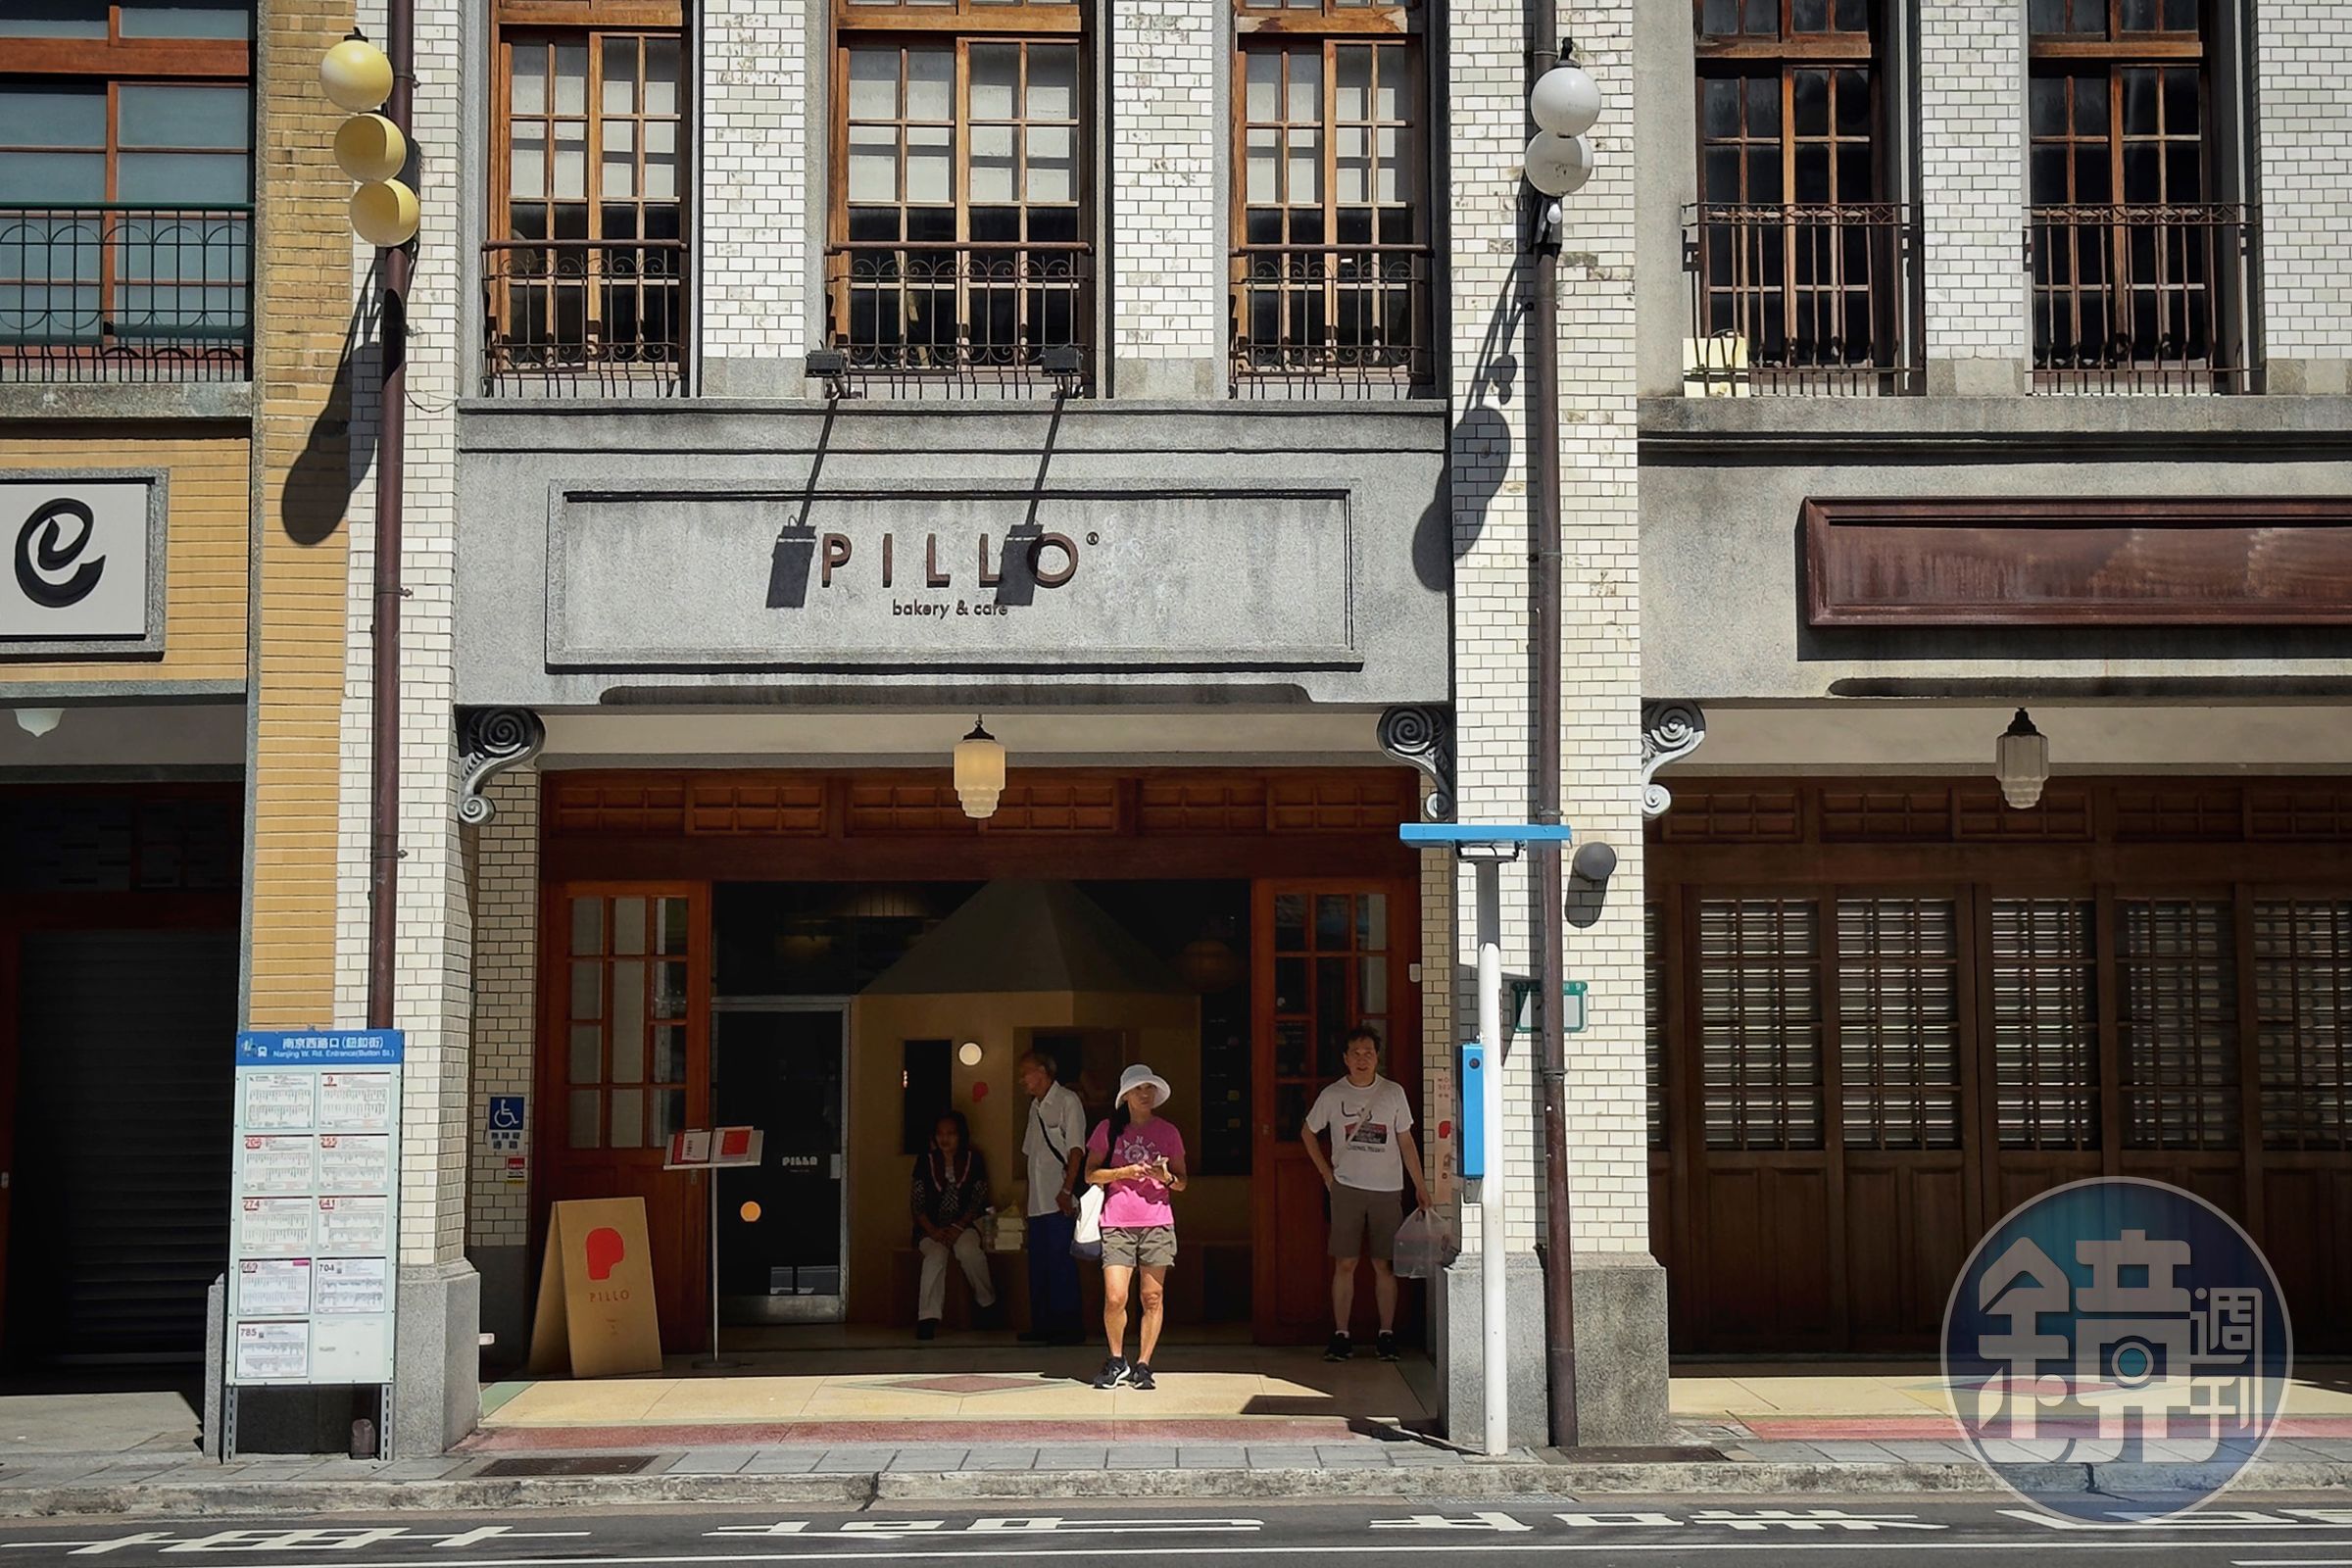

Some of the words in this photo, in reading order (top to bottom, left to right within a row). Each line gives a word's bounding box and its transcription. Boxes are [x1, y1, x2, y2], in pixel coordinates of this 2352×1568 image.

[893, 599, 950, 619] bakery
[956, 601, 969, 616] &
[326, 1076, 334, 1085] 9
[589, 1289, 629, 1302] PILLO
[240, 1328, 257, 1337] 785
